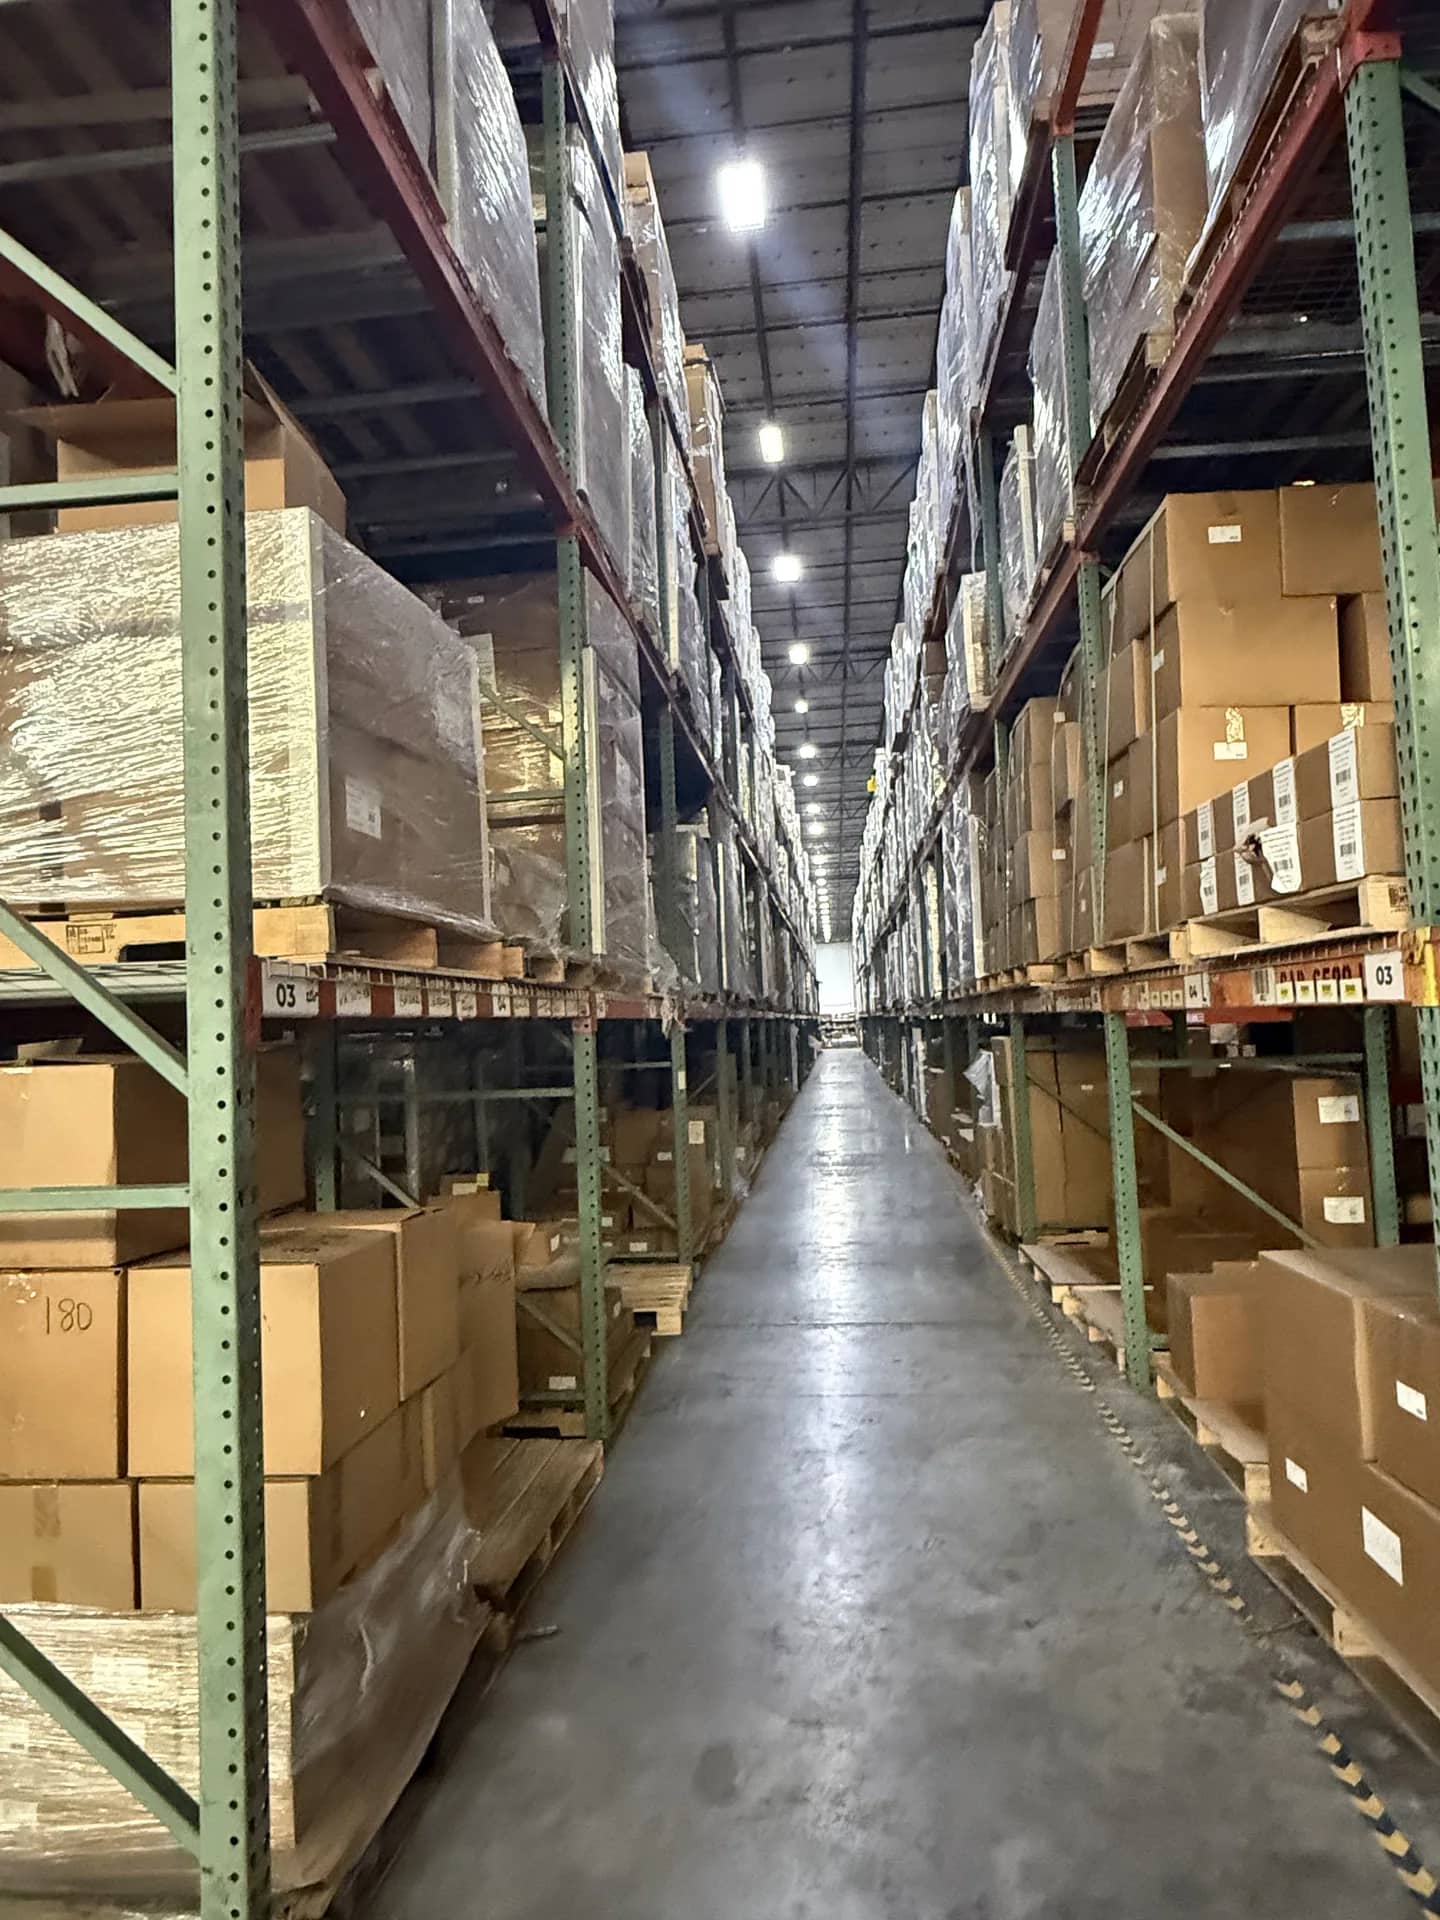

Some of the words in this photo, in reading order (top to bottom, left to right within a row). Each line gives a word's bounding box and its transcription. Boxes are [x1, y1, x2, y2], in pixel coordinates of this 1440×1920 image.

[1376, 966, 1392, 985] 03
[276, 983, 296, 1007] 03
[44, 1295, 93, 1335] 180
